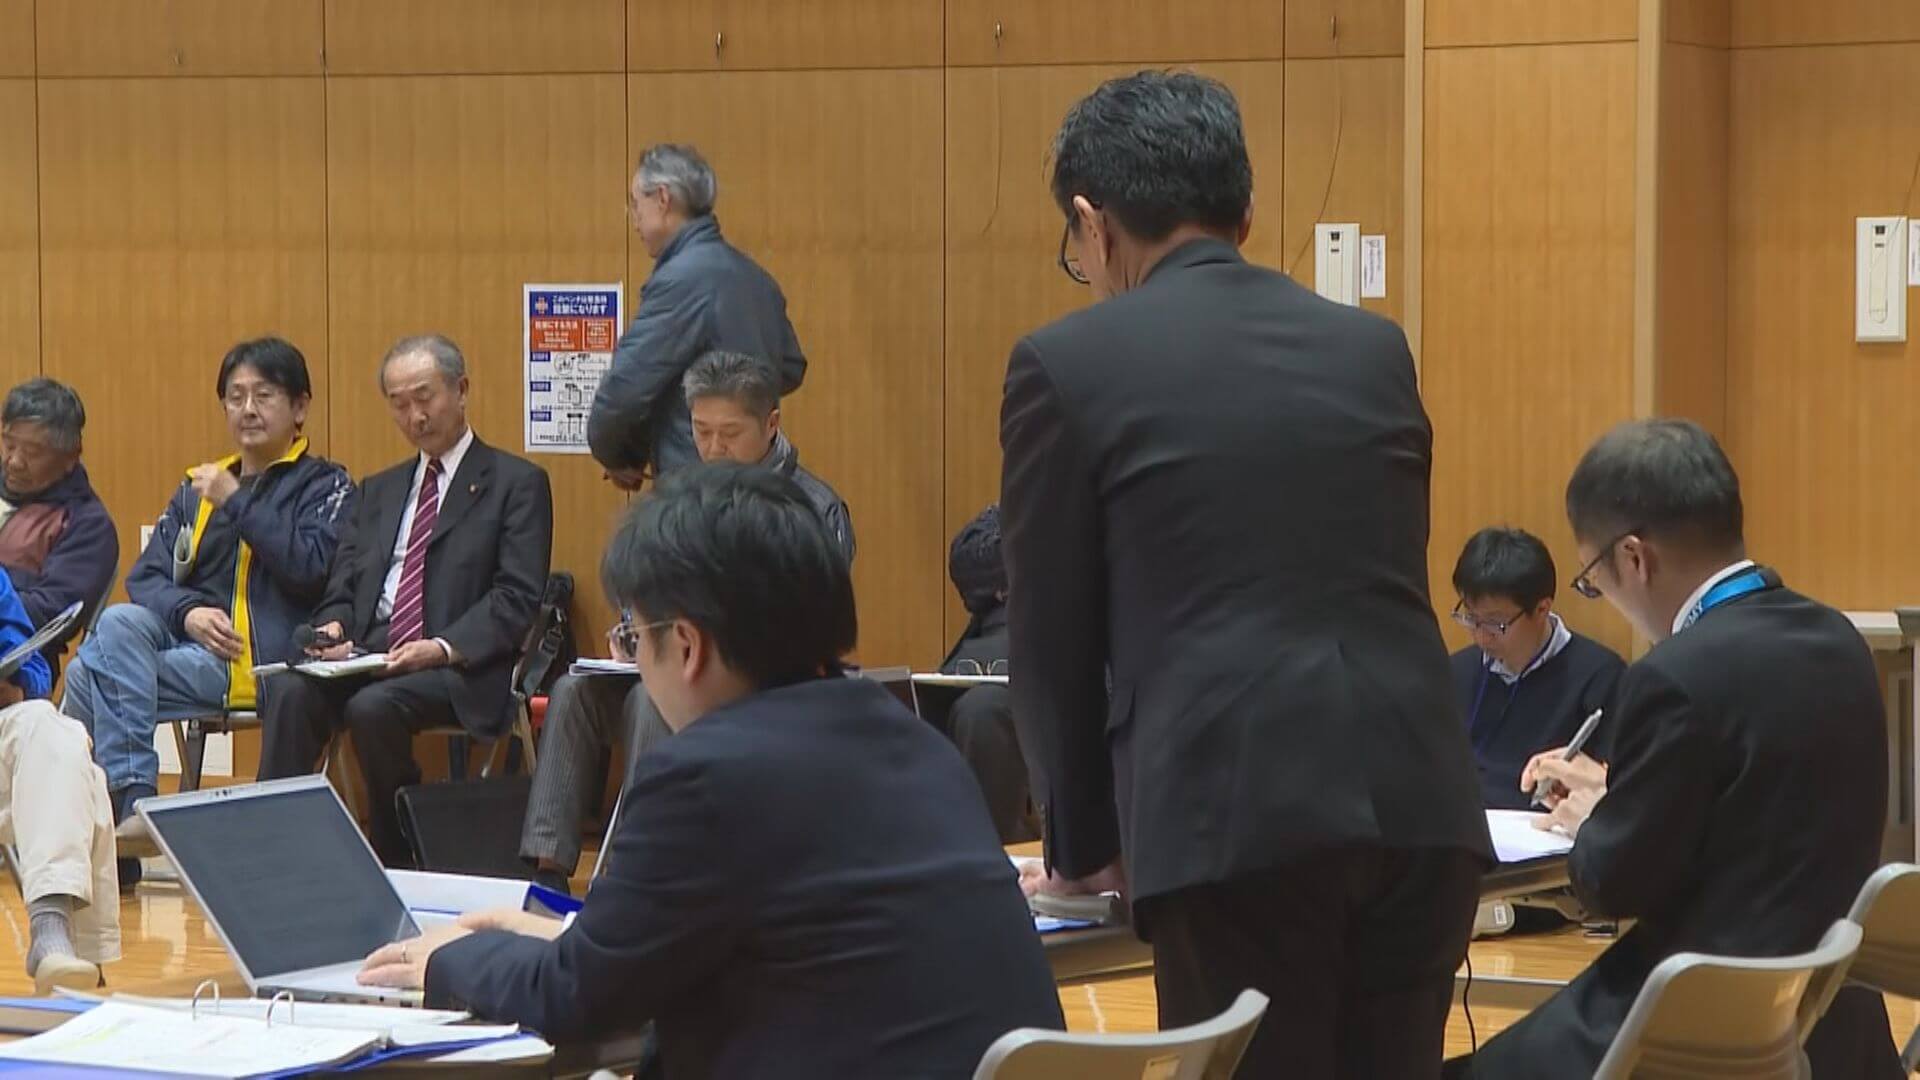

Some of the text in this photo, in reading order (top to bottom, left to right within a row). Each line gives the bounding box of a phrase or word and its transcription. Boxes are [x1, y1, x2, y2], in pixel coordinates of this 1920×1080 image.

[552, 304, 608, 315] になります
